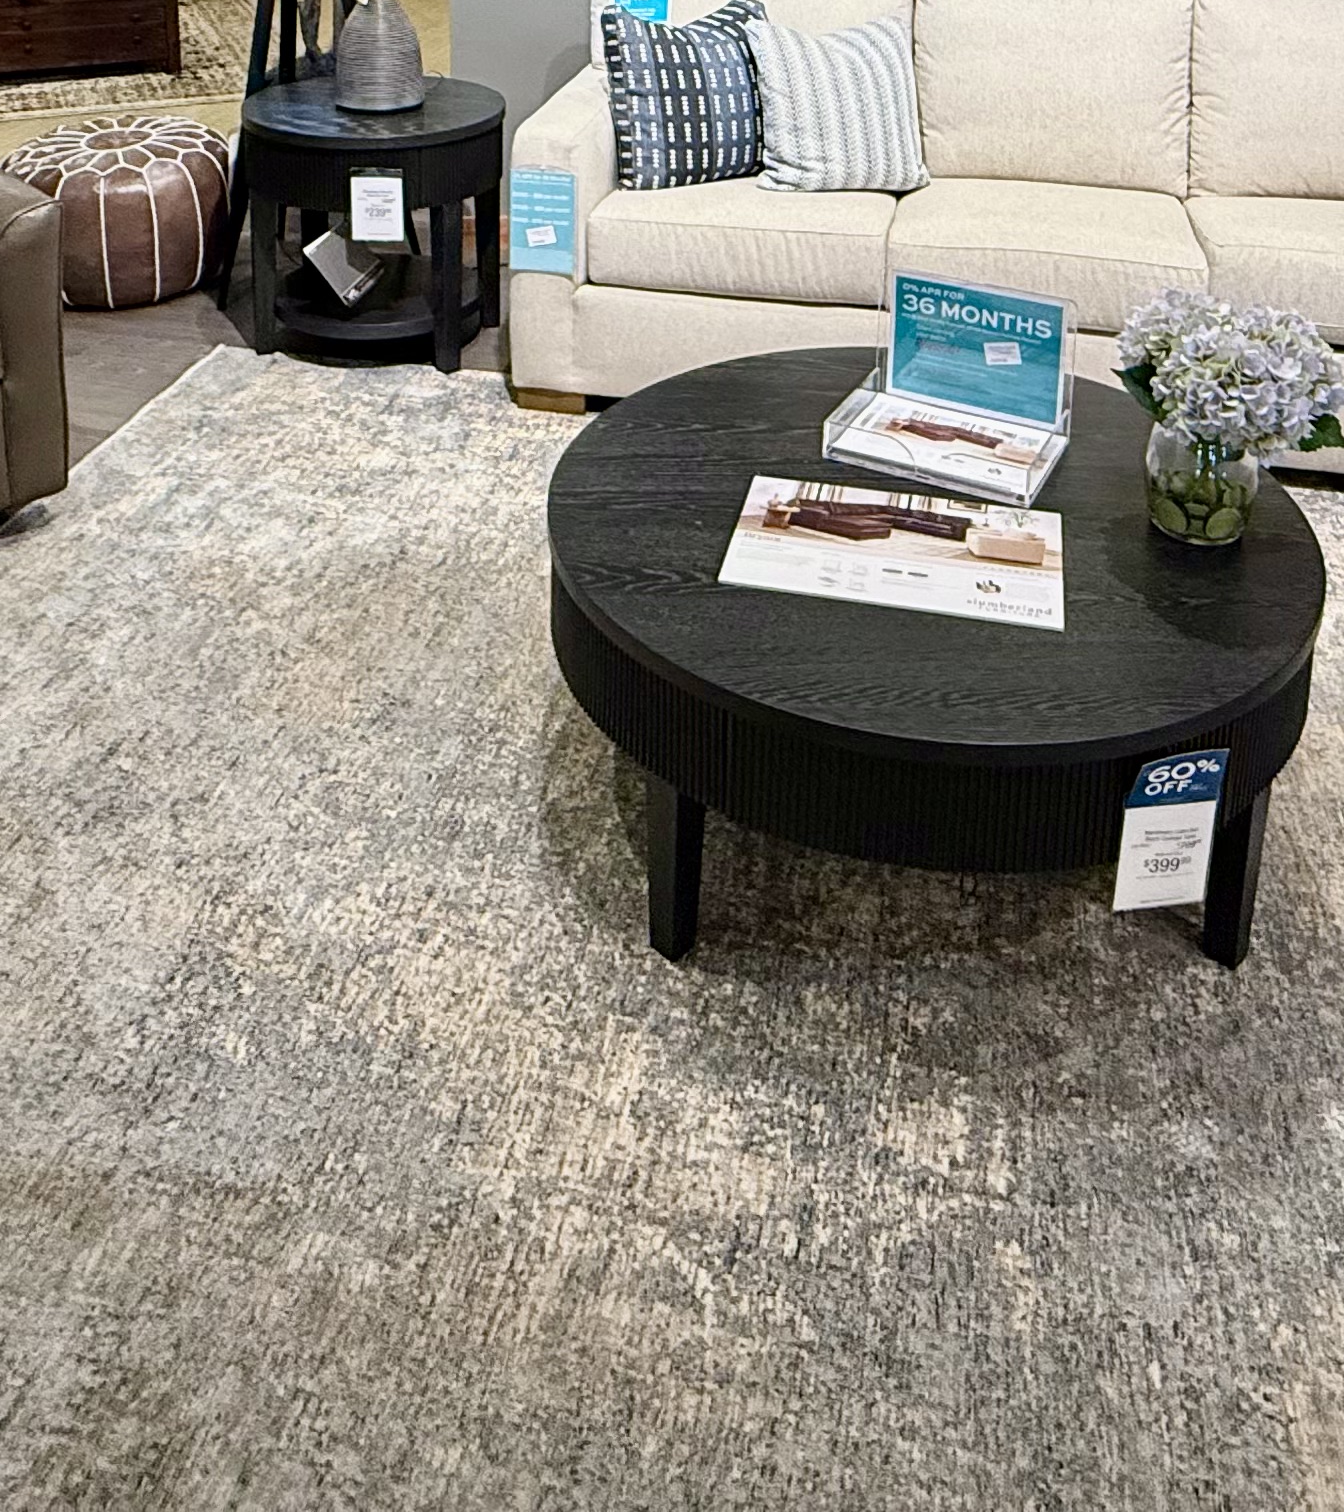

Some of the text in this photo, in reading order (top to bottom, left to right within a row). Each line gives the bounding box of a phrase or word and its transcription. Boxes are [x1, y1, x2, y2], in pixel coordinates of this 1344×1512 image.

[902, 282, 965, 301] 0% APR FOR
[902, 293, 935, 315] 36
[940, 300, 1053, 339] MONTHS
[1147, 758, 1221, 783] 60%
[1144, 779, 1193, 796] OFF
